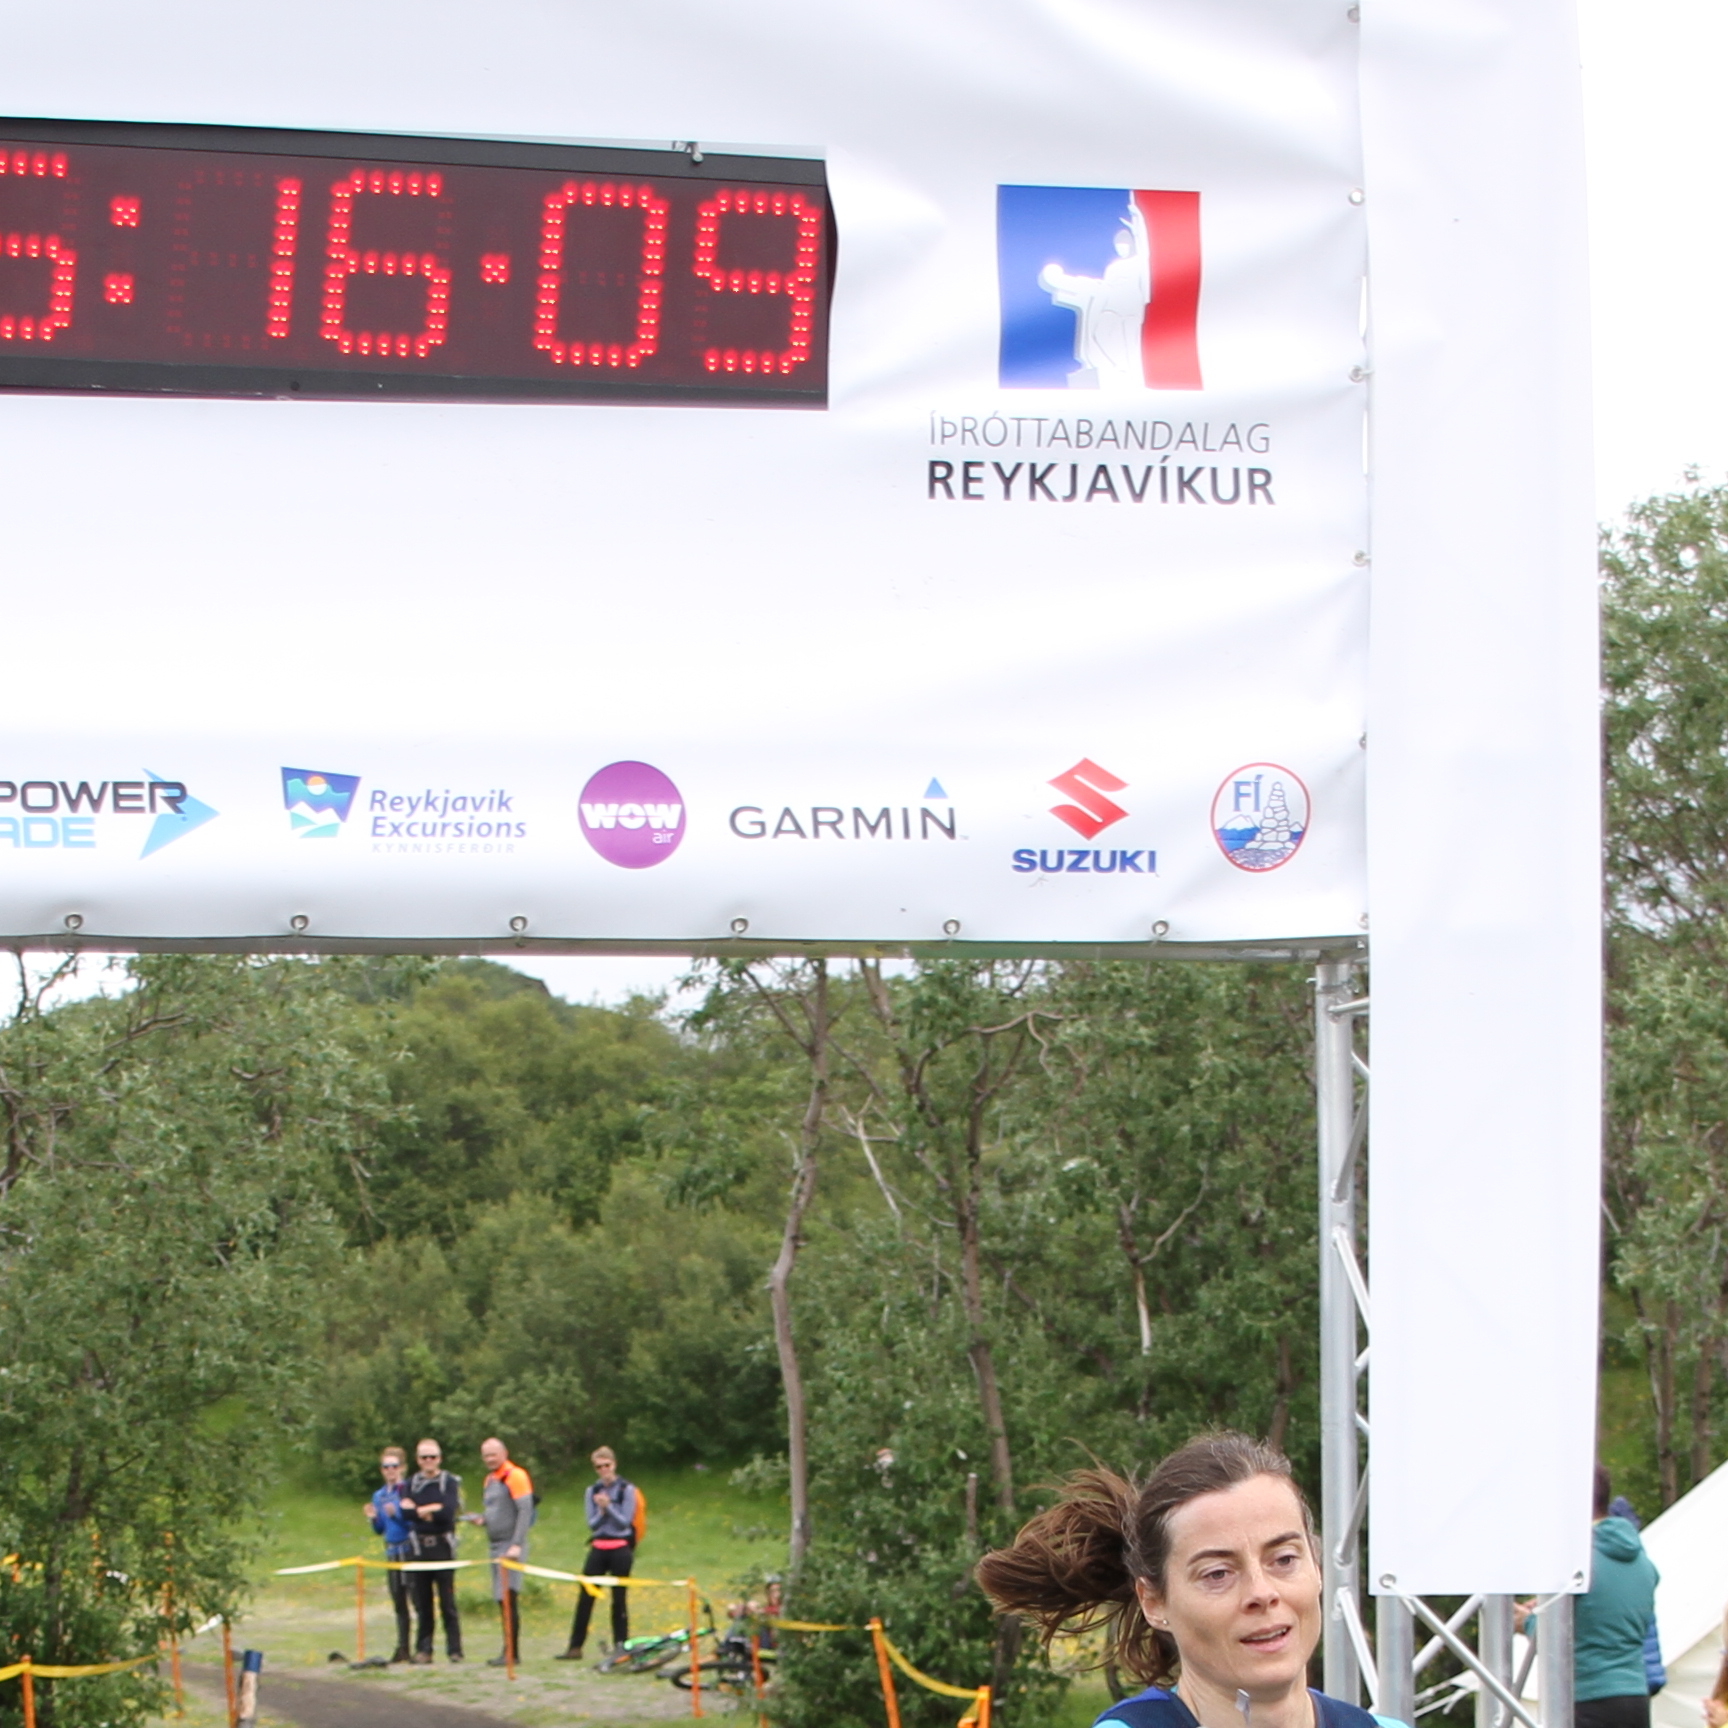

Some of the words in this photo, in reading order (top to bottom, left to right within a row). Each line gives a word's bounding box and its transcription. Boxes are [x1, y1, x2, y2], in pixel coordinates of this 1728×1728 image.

[929, 411, 1271, 454] ÍÞRÓTTABANDALAG
[927, 456, 1275, 505] REYKJAVÍKUR
[369, 788, 514, 819] Reykjavik
[370, 815, 527, 839] Excursions
[651, 828, 675, 845] air
[728, 805, 957, 841] GARMIN
[1011, 848, 1158, 874] SUZUKI
